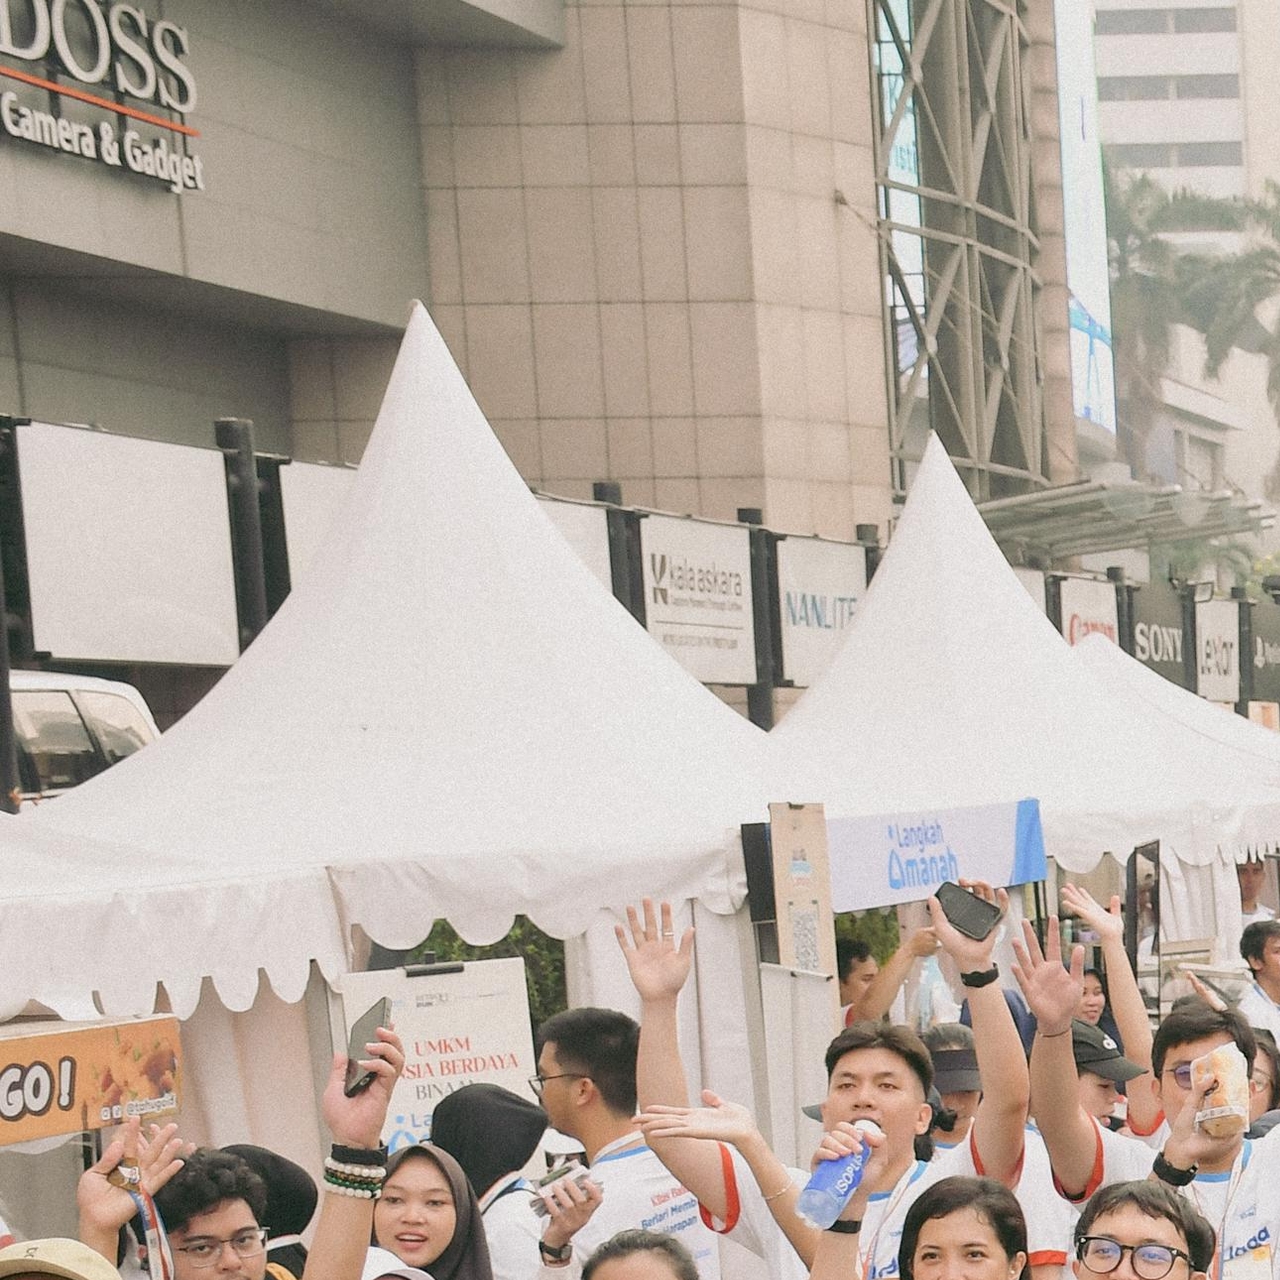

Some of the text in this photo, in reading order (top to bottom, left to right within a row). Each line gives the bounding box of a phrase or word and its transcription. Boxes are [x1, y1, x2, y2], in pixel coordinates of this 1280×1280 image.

[0, 0, 196, 113] DOSS
[1, 91, 204, 194] Camera & Gadget
[1134, 622, 1183, 663] SONY
[415, 1036, 471, 1057] UMKM
[440, 1053, 519, 1077] BERDAYA
[0, 1056, 76, 1121] GO!
